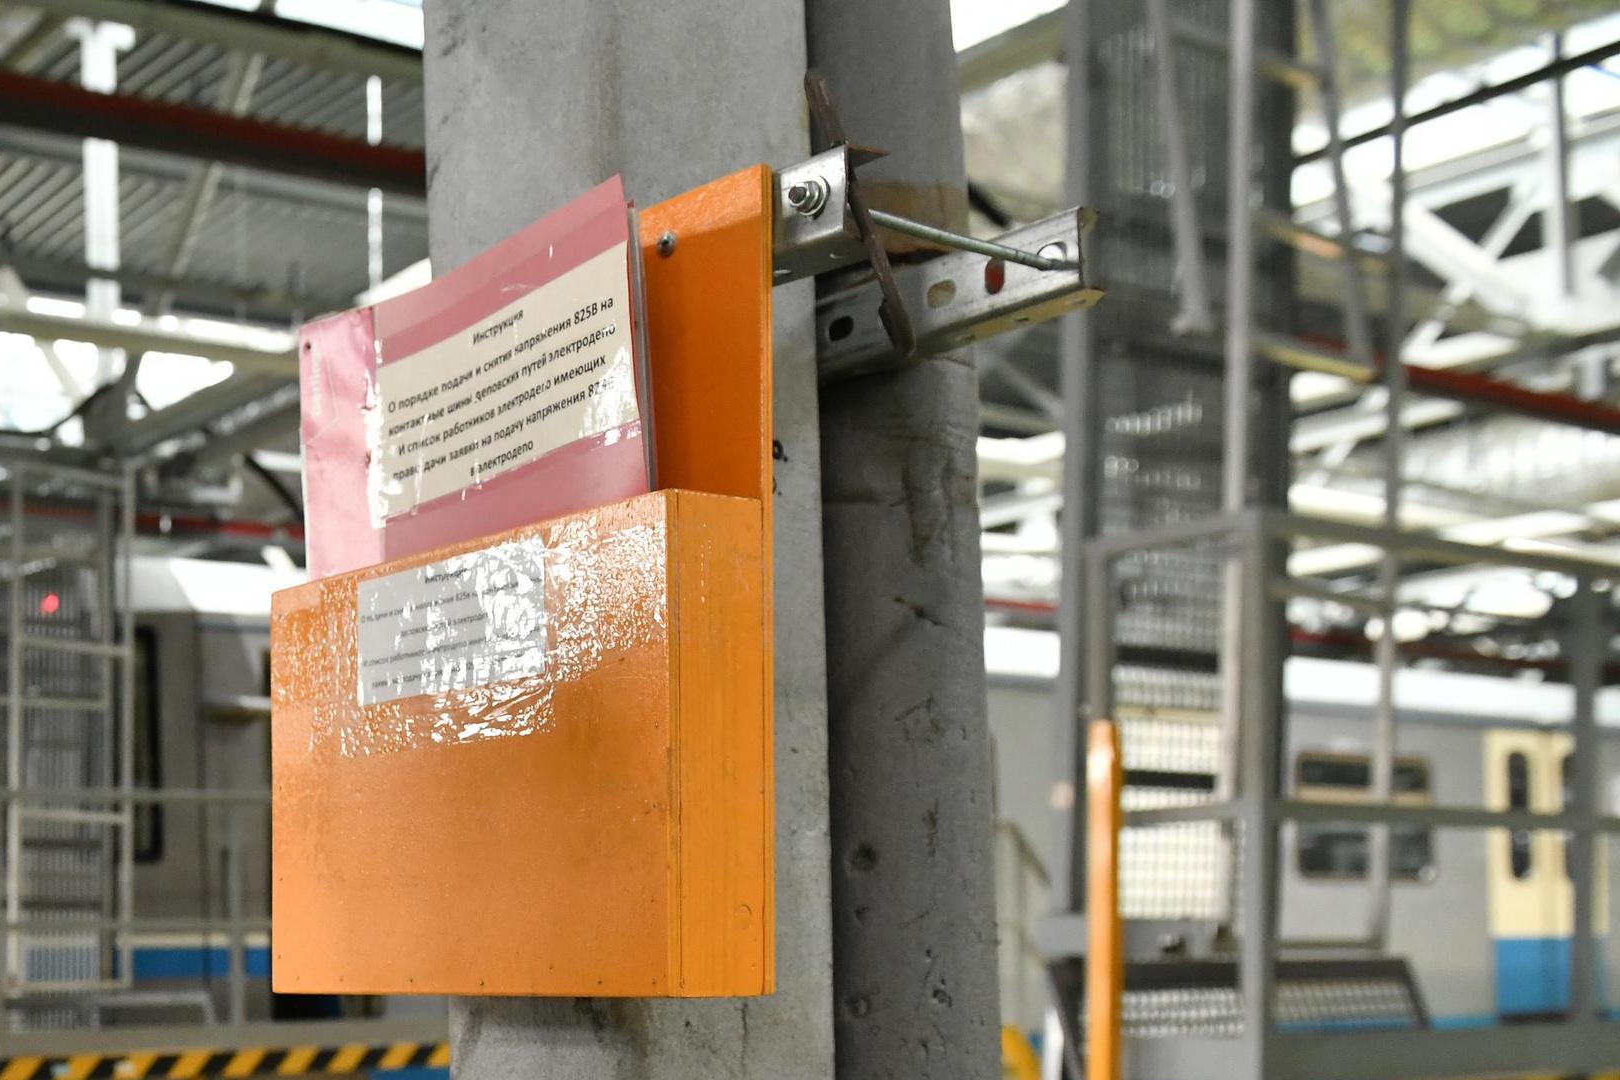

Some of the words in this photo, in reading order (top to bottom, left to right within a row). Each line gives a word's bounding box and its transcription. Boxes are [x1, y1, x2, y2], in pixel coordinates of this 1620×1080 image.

[398, 386, 438, 409] порядке
[441, 370, 473, 392] подачи
[475, 366, 481, 376] и
[573, 302, 598, 325] 825В
[600, 297, 613, 311] на
[521, 352, 546, 376] путей
[443, 408, 495, 442] работников
[553, 354, 606, 386] имеющих
[494, 418, 524, 441] подачу
[526, 390, 585, 425] напряжения
